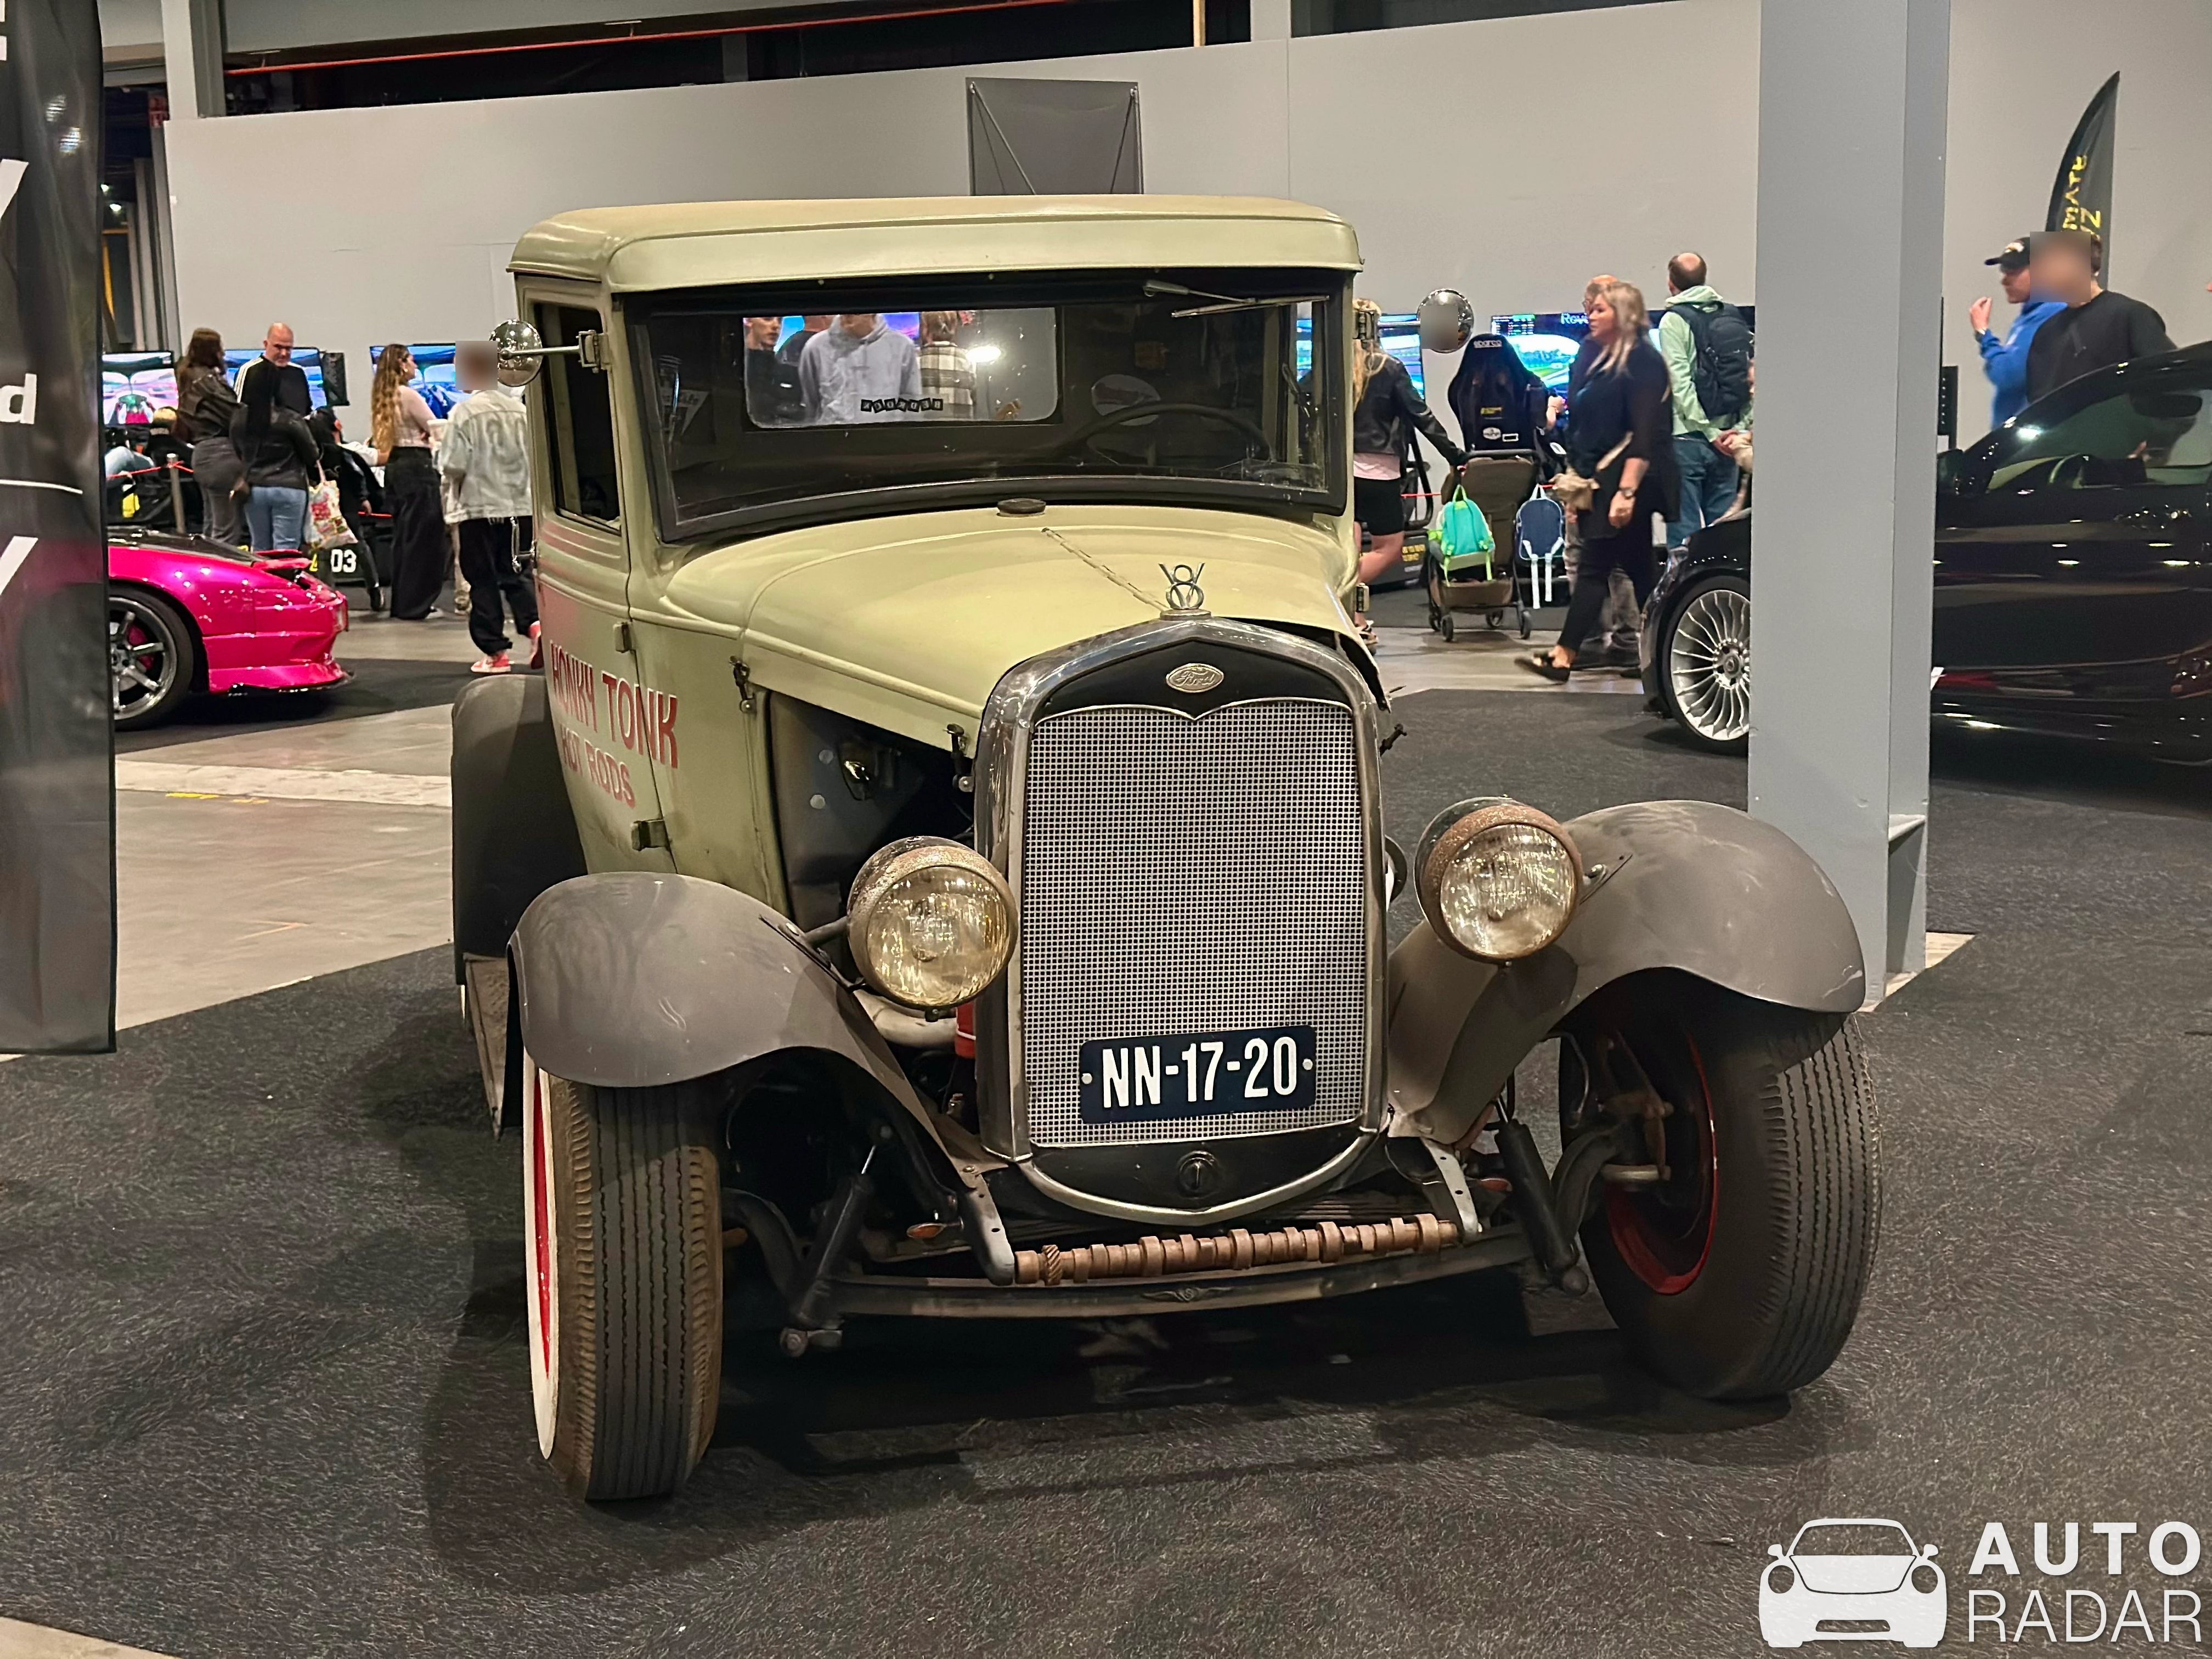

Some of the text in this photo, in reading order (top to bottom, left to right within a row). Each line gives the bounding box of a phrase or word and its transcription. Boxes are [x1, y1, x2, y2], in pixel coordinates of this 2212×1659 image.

[2063, 154, 2087, 231] MATE
[330, 549, 357, 573] 03
[550, 639, 678, 769] HONKY TONK
[1175, 670, 1215, 686] Ford
[560, 723, 635, 811] HOT RODS
[1103, 1036, 1297, 1108] NN-17-20
